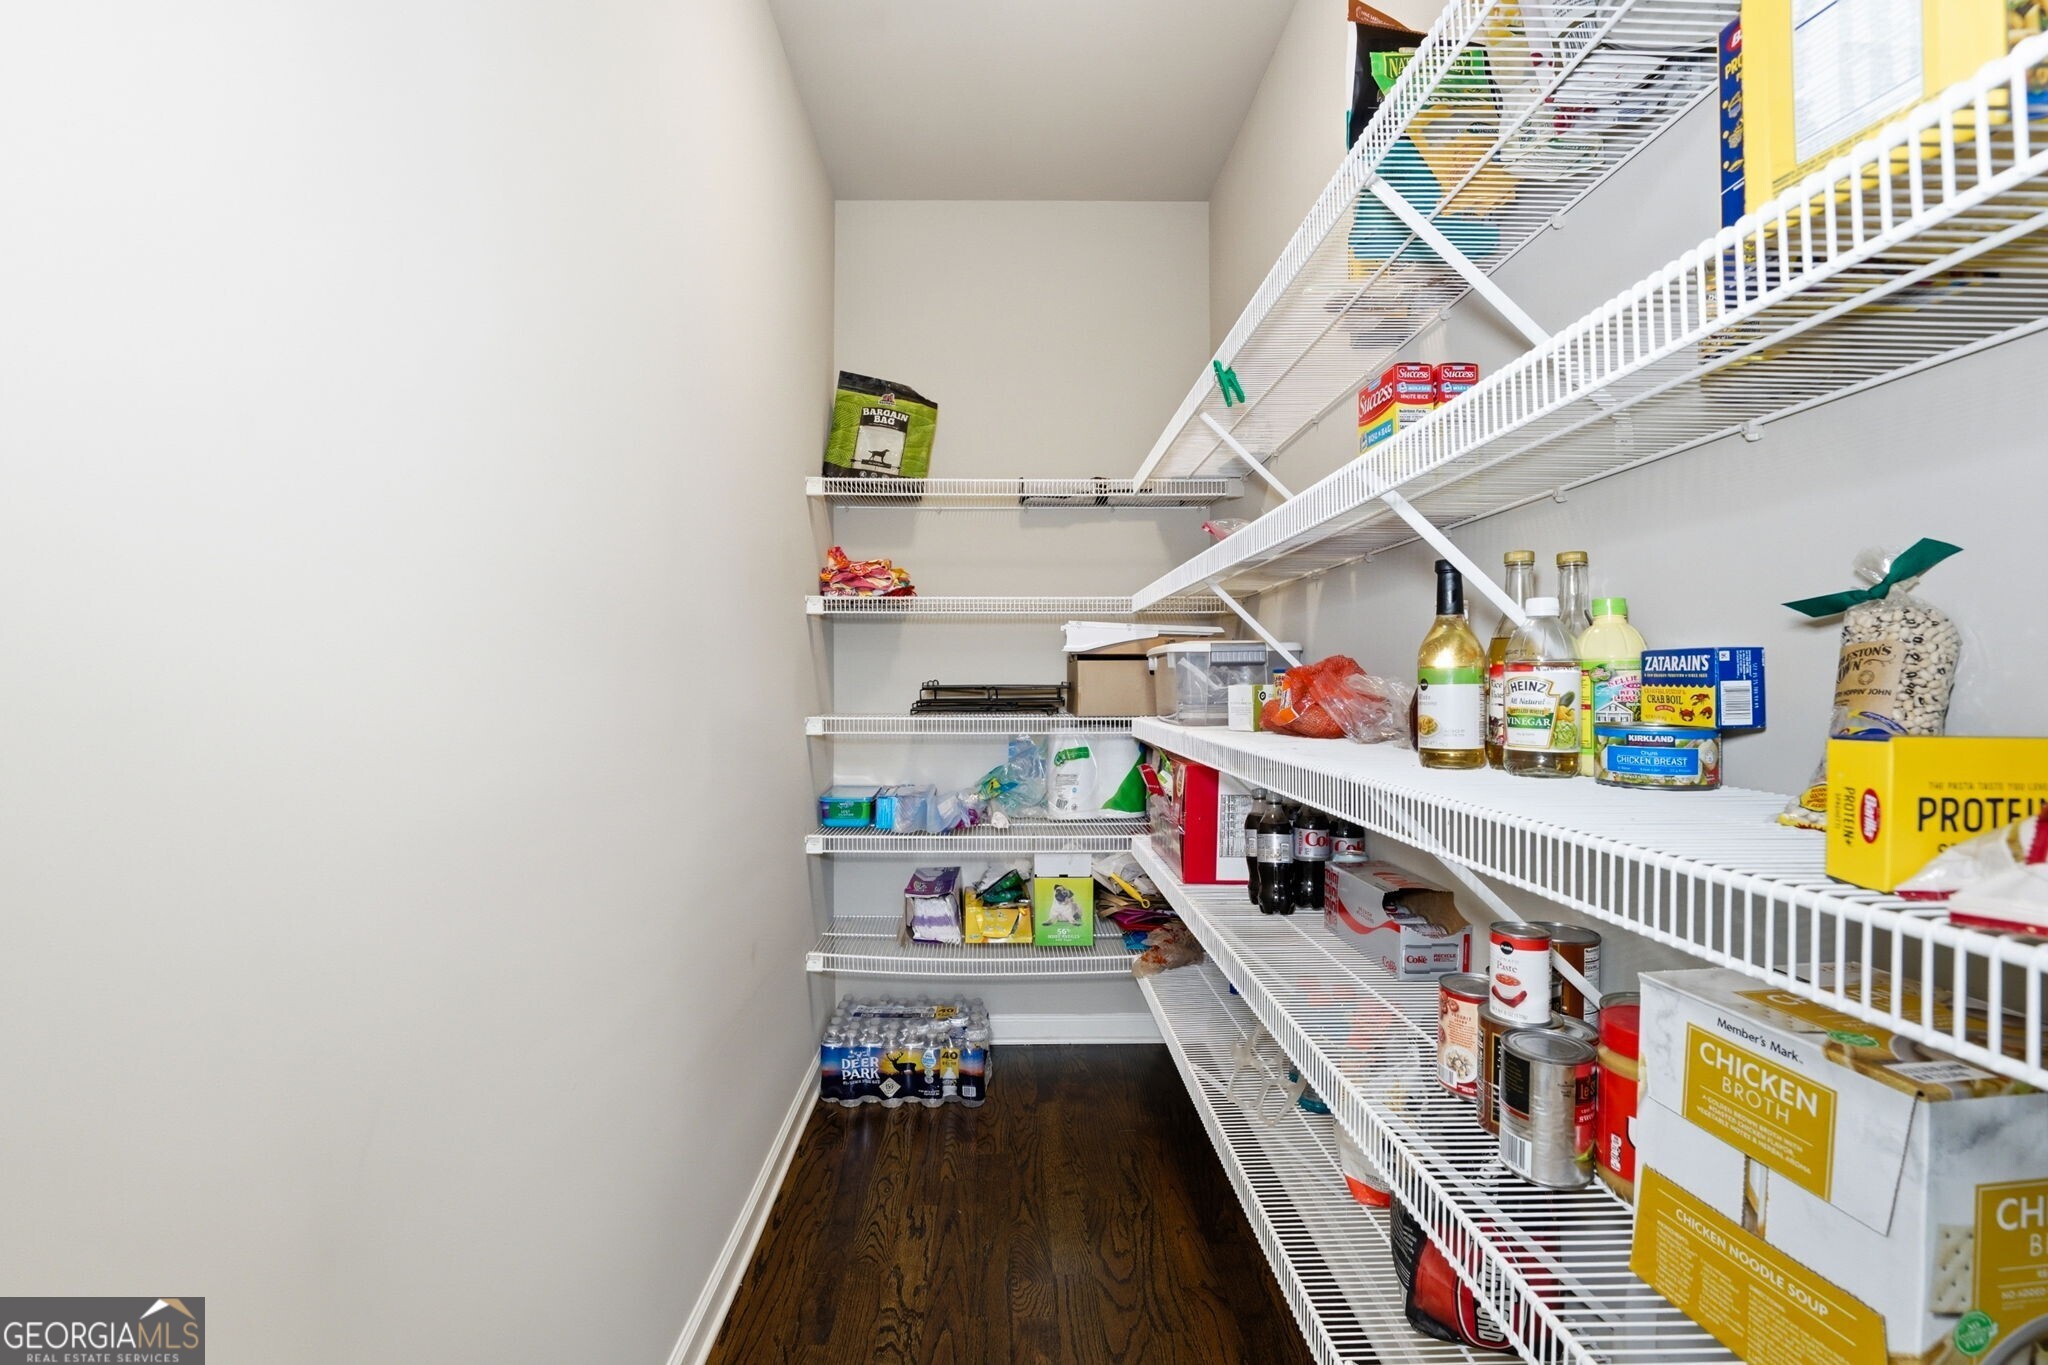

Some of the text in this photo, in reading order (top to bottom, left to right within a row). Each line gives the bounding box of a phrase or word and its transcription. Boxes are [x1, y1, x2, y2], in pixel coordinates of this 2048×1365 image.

[862, 407, 909, 422] BARGAIN
[873, 415, 895, 425] BAG
[1644, 654, 1711, 672] ZATARAIN'S
[1510, 680, 1547, 693] HEINZ
[1868, 688, 1892, 696] JOHN
[1647, 694, 1684, 705] CRAB BOIL
[1507, 716, 1551, 727] VINEGAR
[1628, 734, 1675, 743] KIRKLAND
[1616, 754, 1687, 766] CHICKEN BREAST
[1918, 797, 2048, 833] PROTEI
[1406, 954, 1428, 964] Coke
[1716, 1017, 1800, 1064] Member's Mark
[941, 1051, 958, 1060] 40
[841, 1057, 880, 1070] DEER
[842, 1068, 881, 1080] PARK
[1699, 1041, 1818, 1118] CHICKEN
[1721, 1076, 1790, 1125] BROTH
[1675, 1208, 1727, 1251] CHICKEN
[1728, 1243, 1784, 1288] NOODLE
[1787, 1282, 1830, 1317] SOUP
